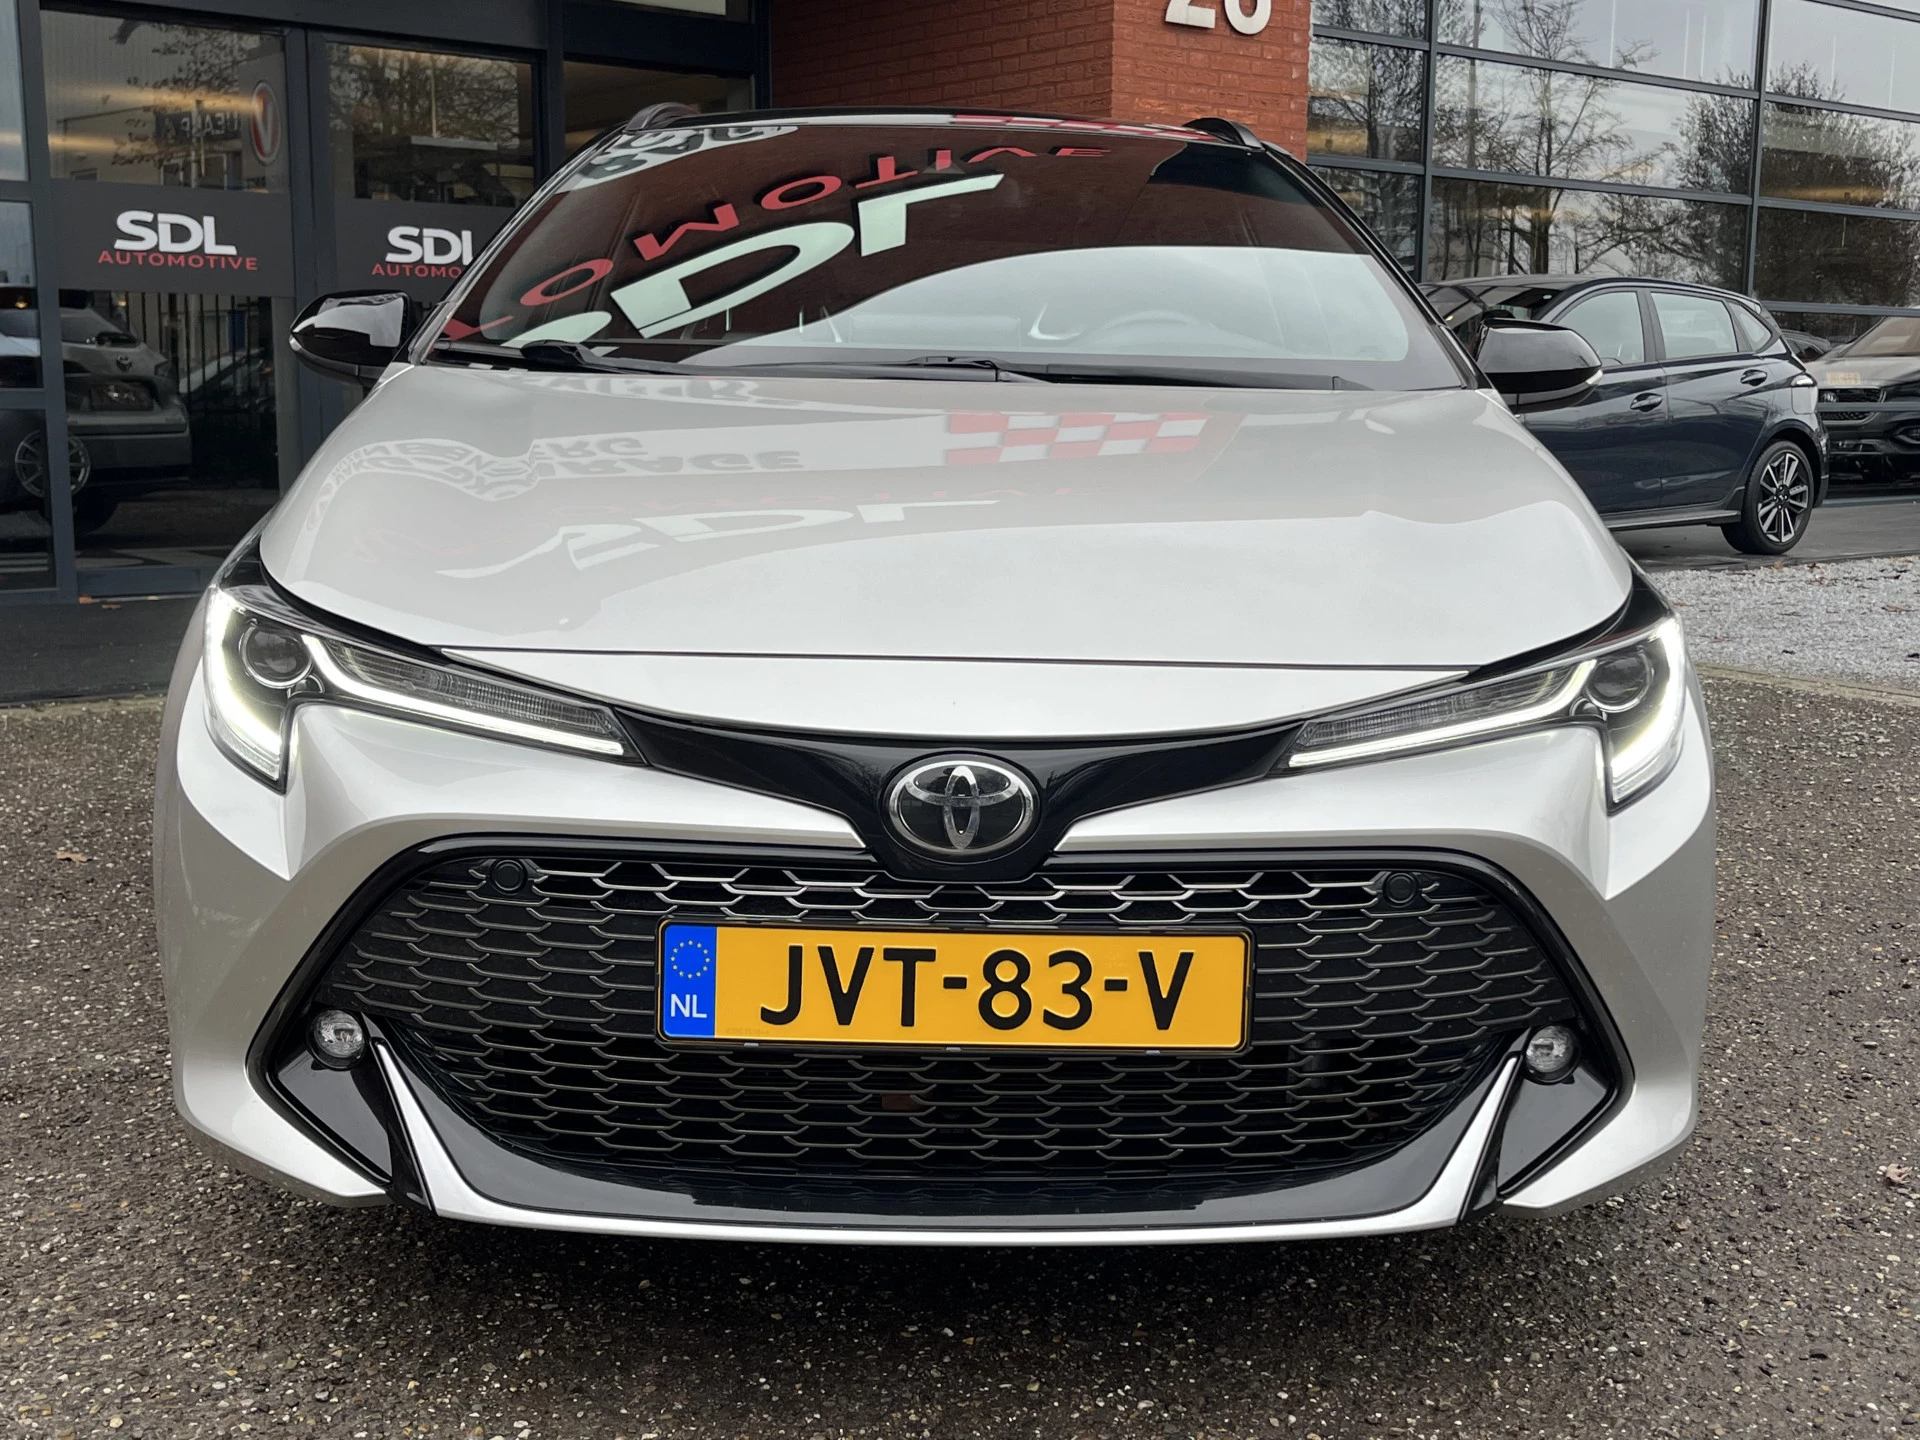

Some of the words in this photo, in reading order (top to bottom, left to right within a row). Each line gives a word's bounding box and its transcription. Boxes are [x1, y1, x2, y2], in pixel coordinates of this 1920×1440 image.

[114, 210, 237, 255] SDL
[98, 250, 258, 271] AUTOMOTIVE
[760, 945, 1195, 1031] JVT-83-V
[670, 994, 707, 1019] NL
